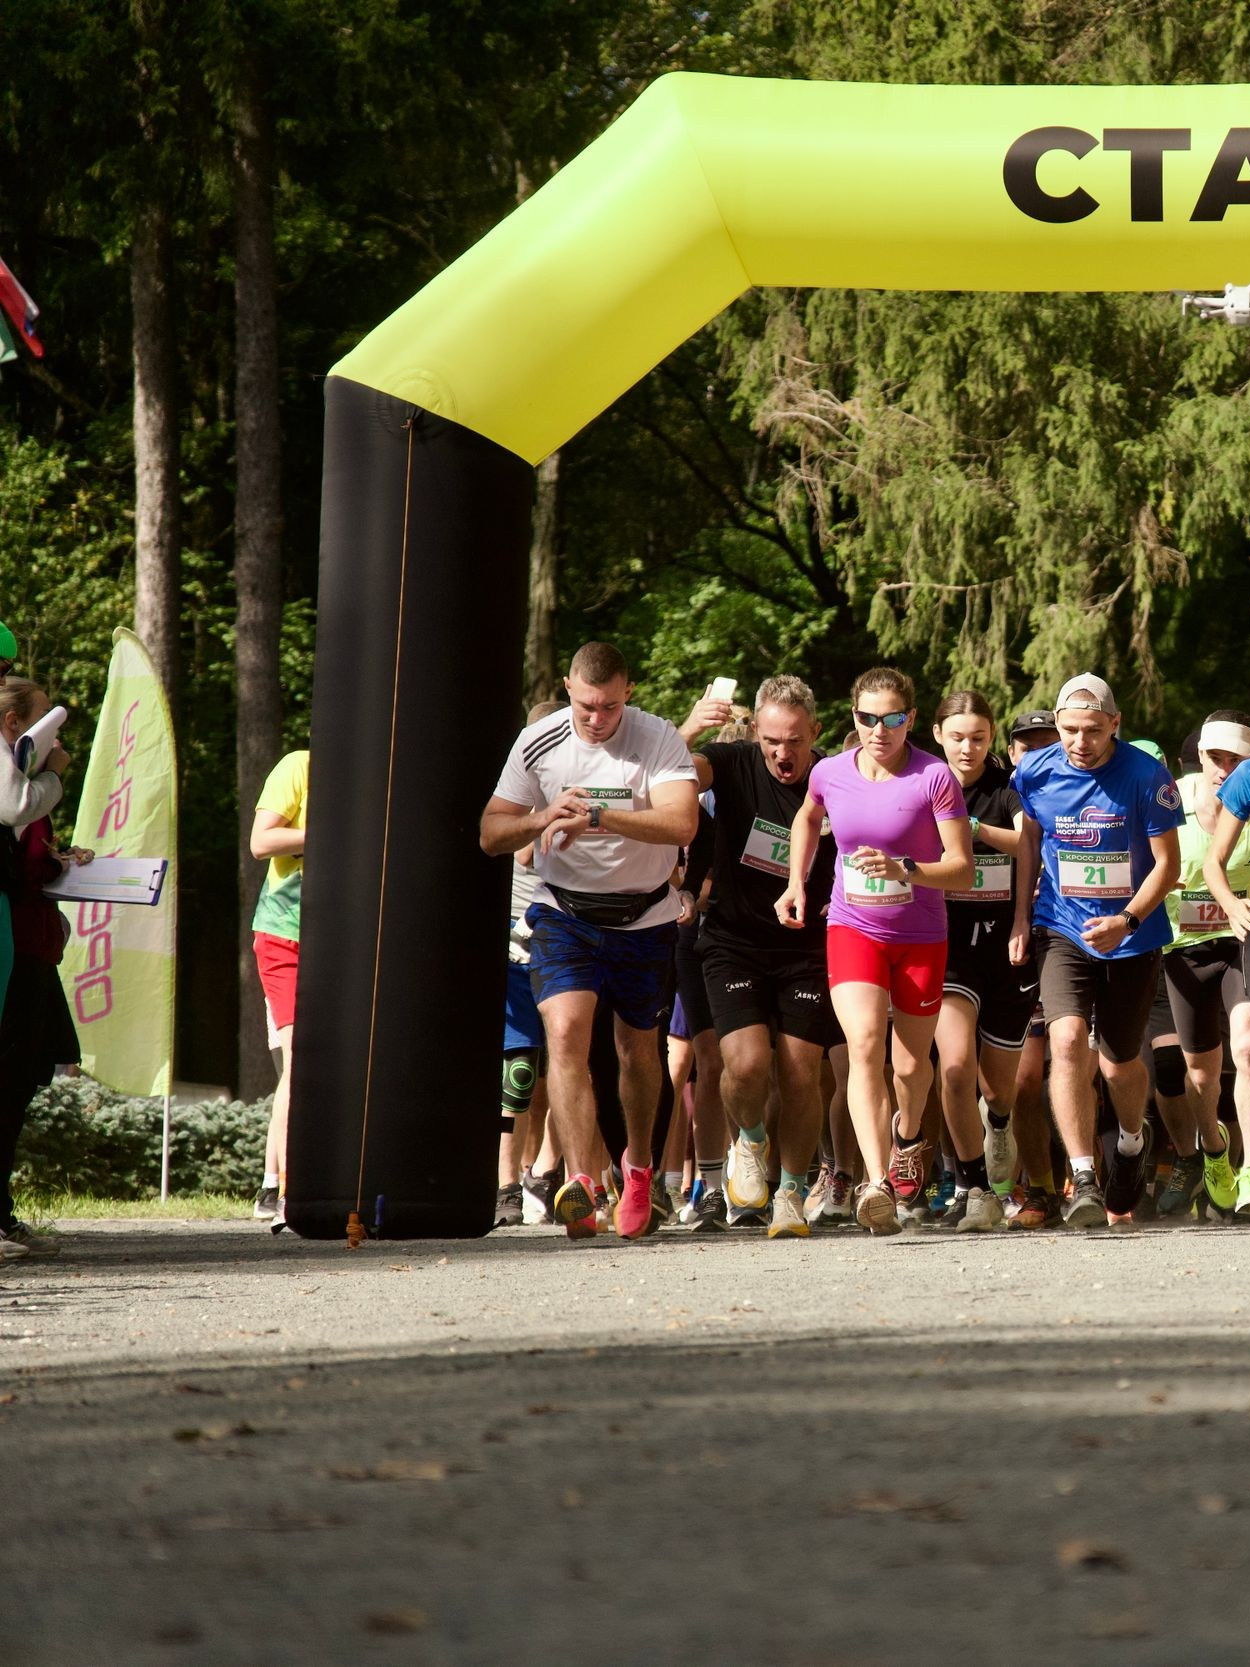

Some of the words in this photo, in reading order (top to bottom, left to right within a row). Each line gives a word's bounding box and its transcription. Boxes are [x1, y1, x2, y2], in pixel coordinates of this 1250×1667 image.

[597, 790, 627, 798] ДУБКИ
[1055, 821, 1125, 829] ПРОМЫШЛЕННОСТИ
[760, 823, 787, 838] КРОСС
[978, 857, 1005, 865] ДУБКИ
[1084, 866, 1106, 885] 21
